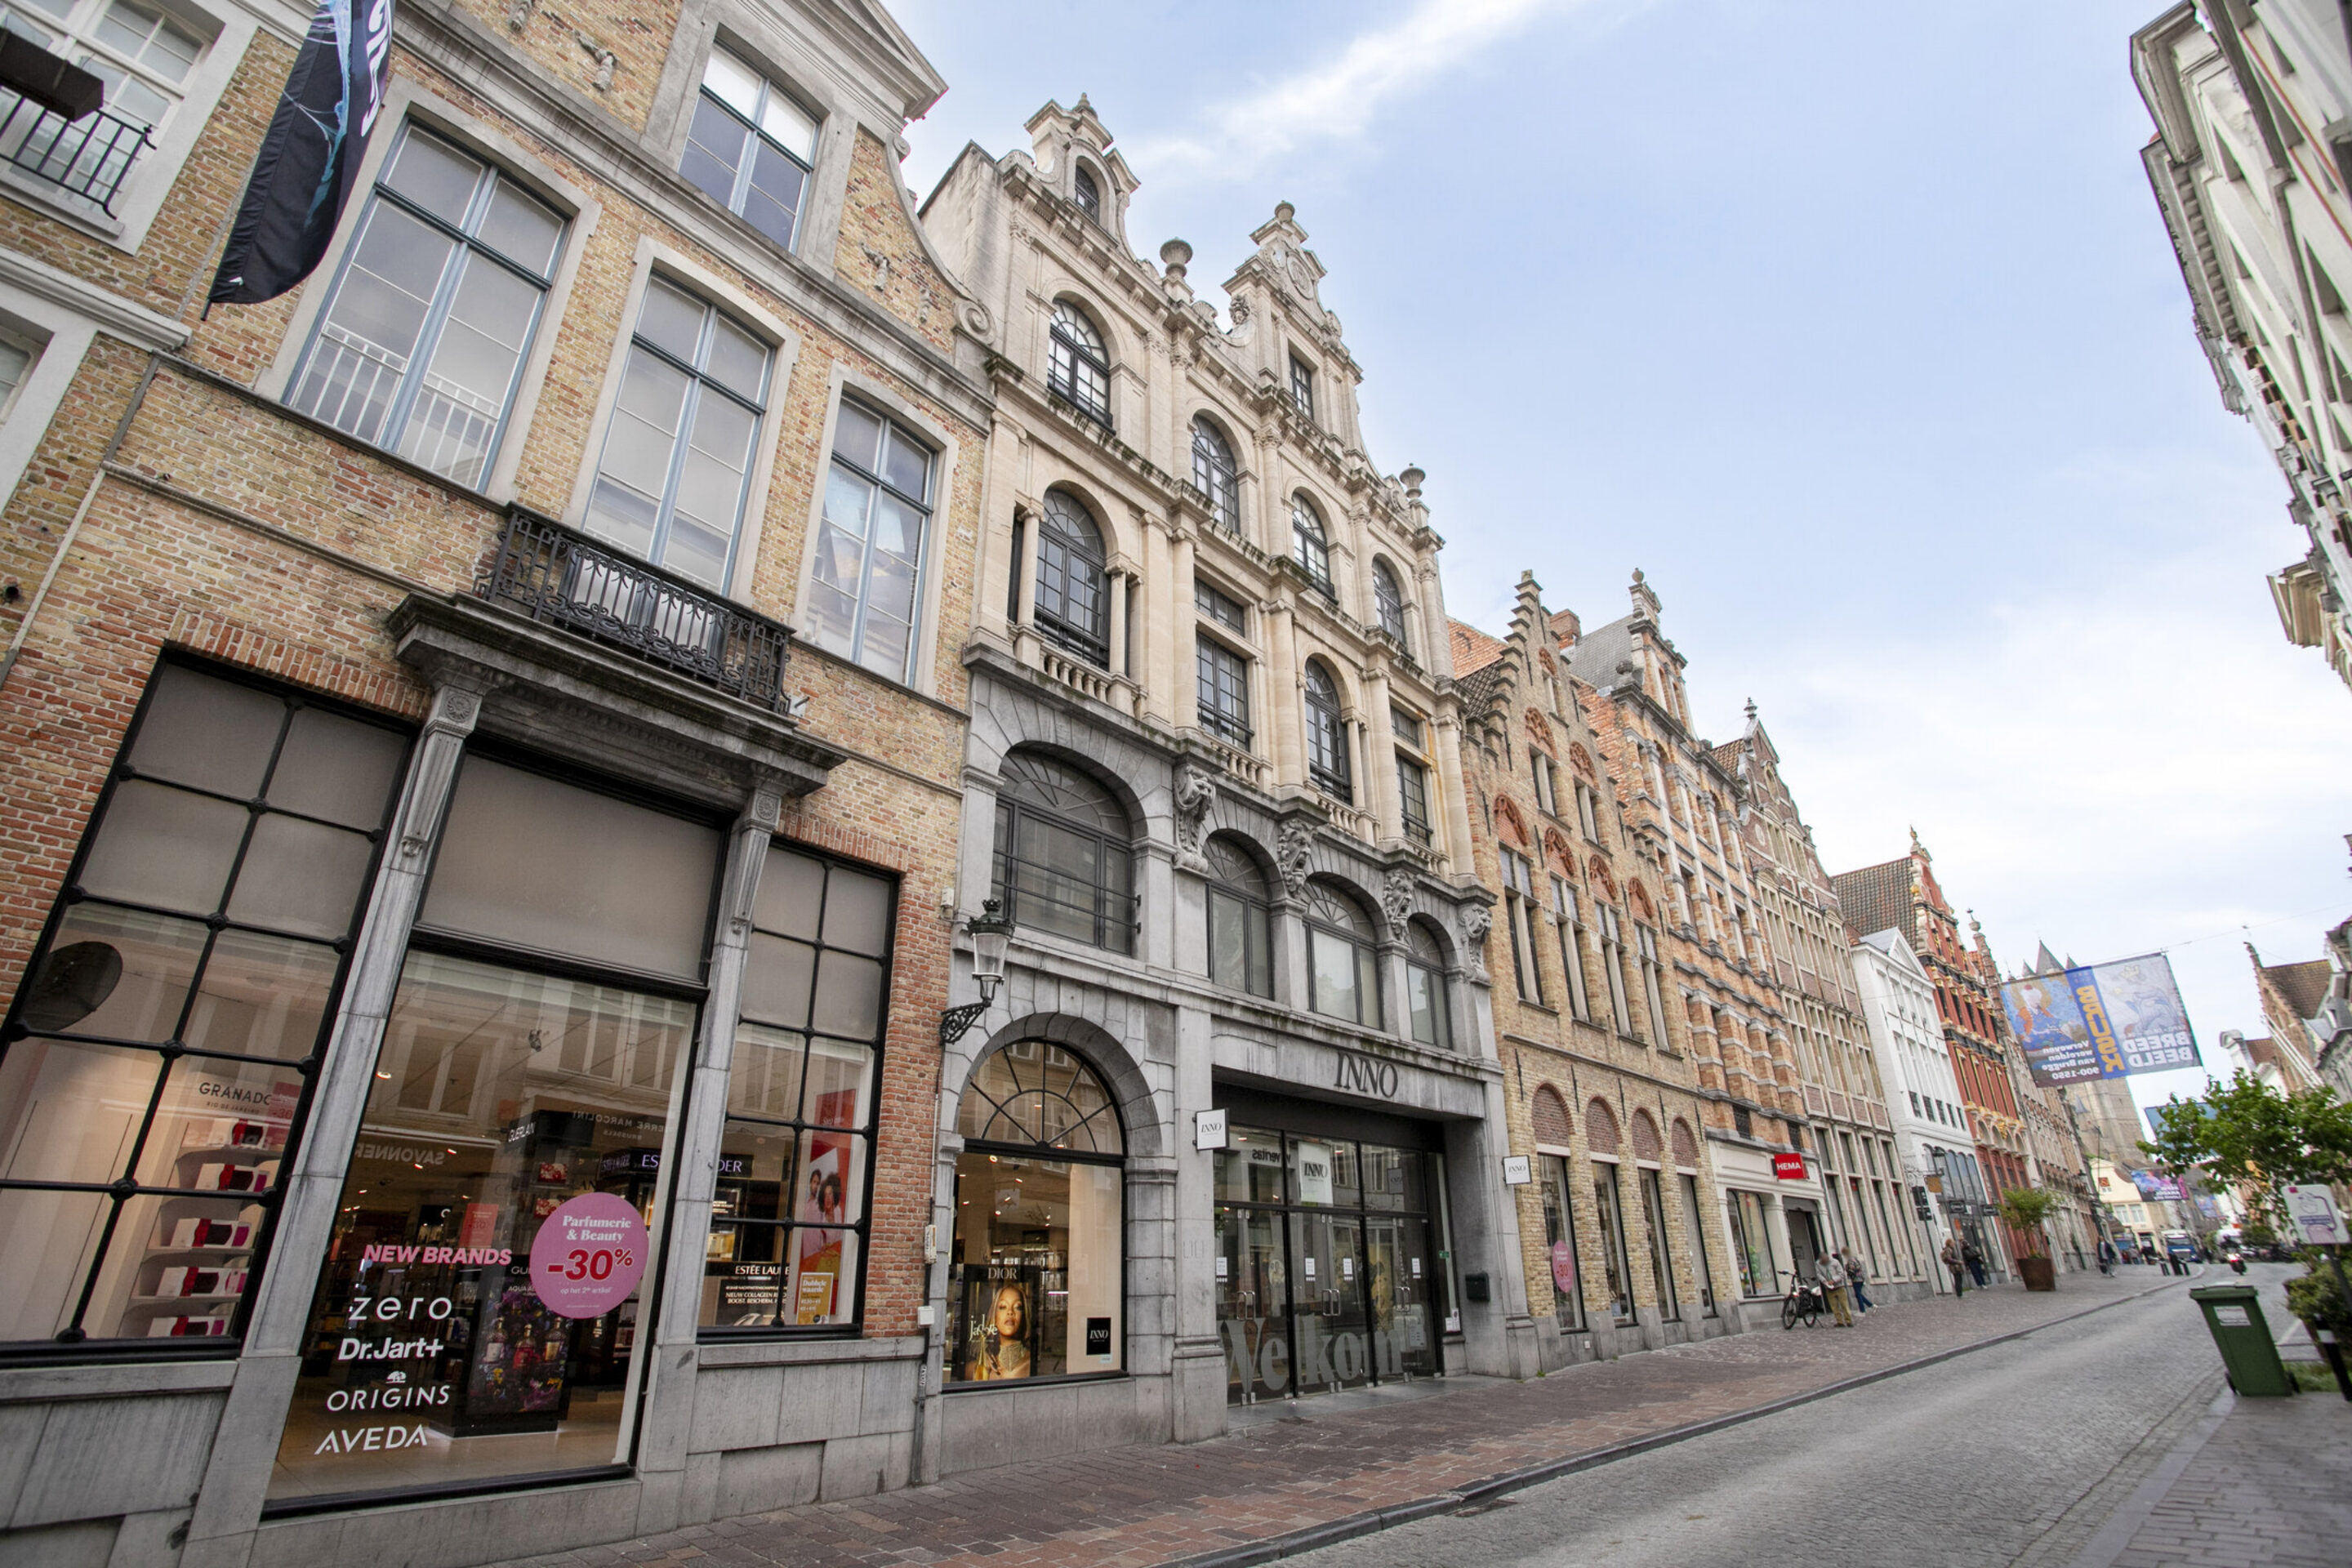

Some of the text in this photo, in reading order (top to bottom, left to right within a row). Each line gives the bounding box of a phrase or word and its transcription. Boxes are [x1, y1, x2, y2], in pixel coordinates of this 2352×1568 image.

[1334, 1052, 1398, 1098] INNO
[1201, 1123, 1223, 1133] INNO
[1304, 1163, 1328, 1178] INNO
[1776, 1162, 1802, 1170] HEMA
[563, 1215, 631, 1228] Parfumerie
[566, 1229, 625, 1243] & Beauty
[363, 1245, 512, 1265] NEW BRANDS
[546, 1248, 634, 1281] -30%
[735, 1264, 760, 1275] ESTÉE
[987, 1267, 1018, 1280] DIOR
[349, 1297, 452, 1321] zero
[1089, 1330, 1108, 1339] INNO
[337, 1337, 444, 1361] Dr.Jart+
[1218, 1311, 1404, 1394] Welkom
[327, 1385, 451, 1411] ORIGINS
[314, 1423, 428, 1455] AVEDA
